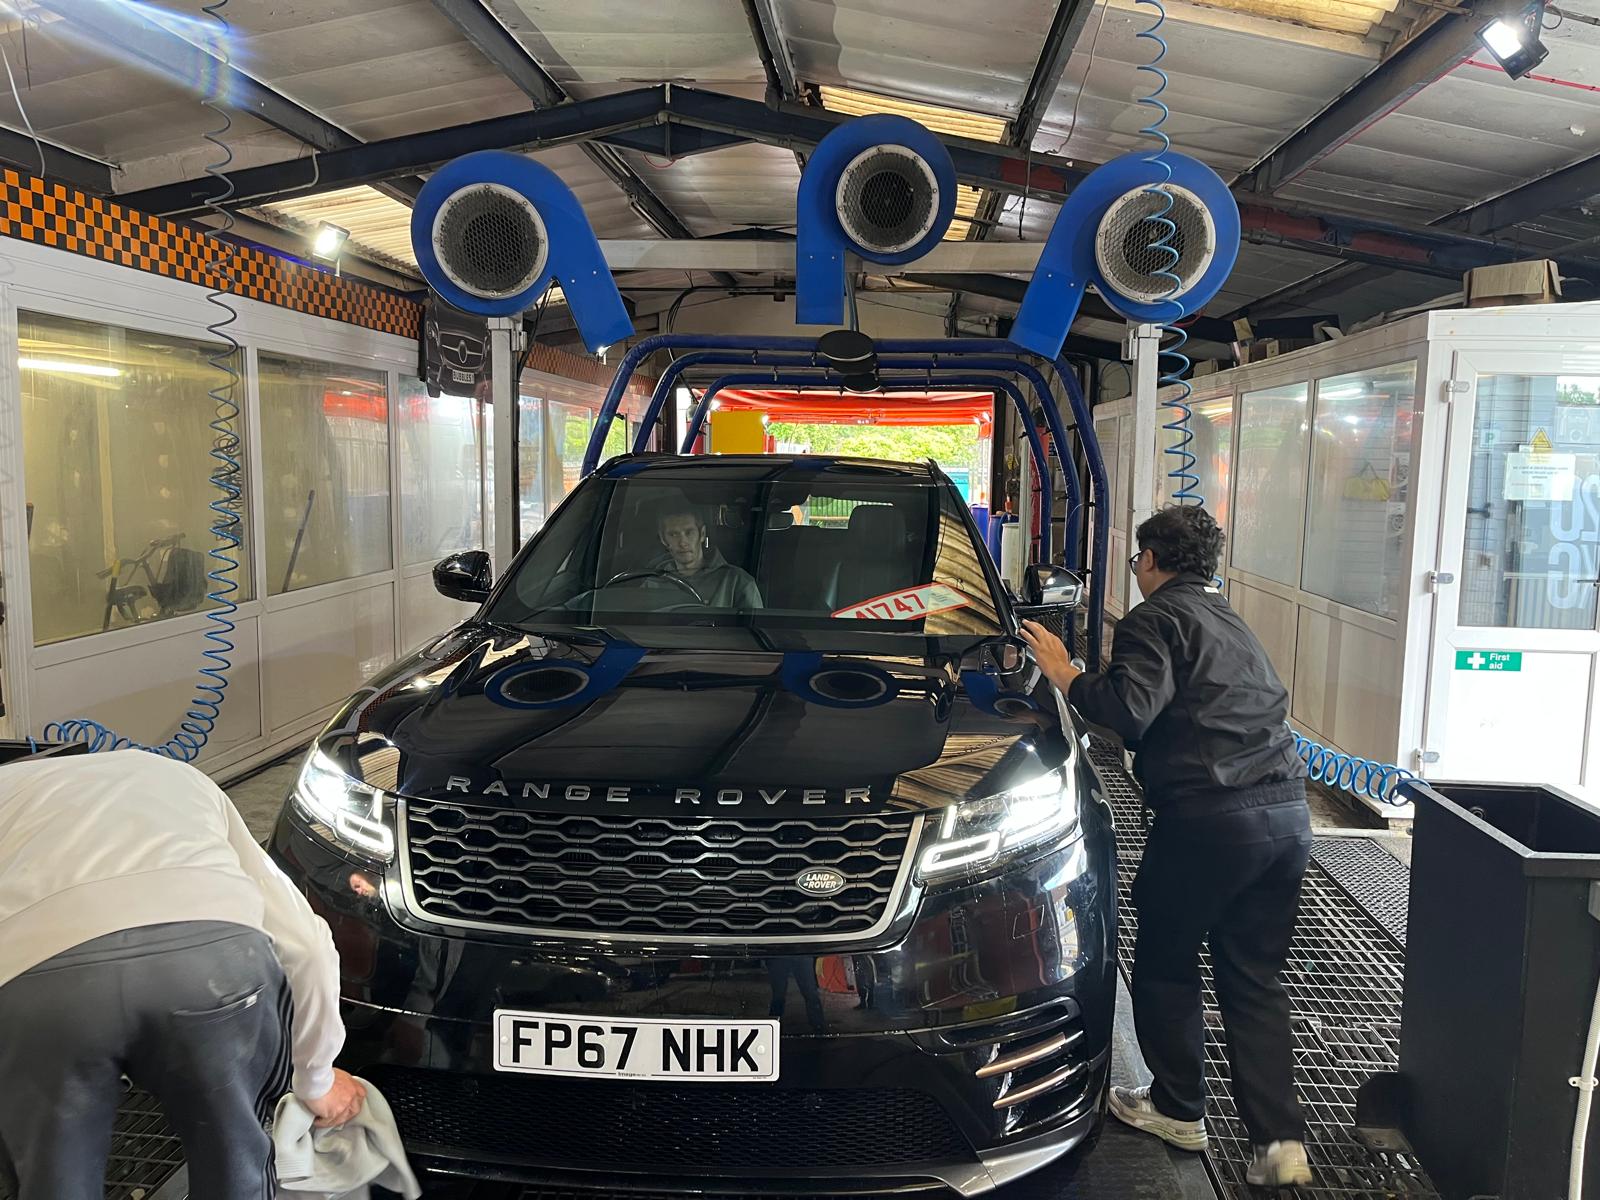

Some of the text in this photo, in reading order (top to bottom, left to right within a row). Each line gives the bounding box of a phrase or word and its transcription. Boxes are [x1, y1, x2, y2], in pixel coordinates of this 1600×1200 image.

[1489, 653, 1510, 661] First
[446, 775, 871, 805] RANGE ROVER
[806, 873, 830, 881] LAND
[808, 881, 837, 889] ROVER
[512, 1019, 759, 1072] FP67 NHK
